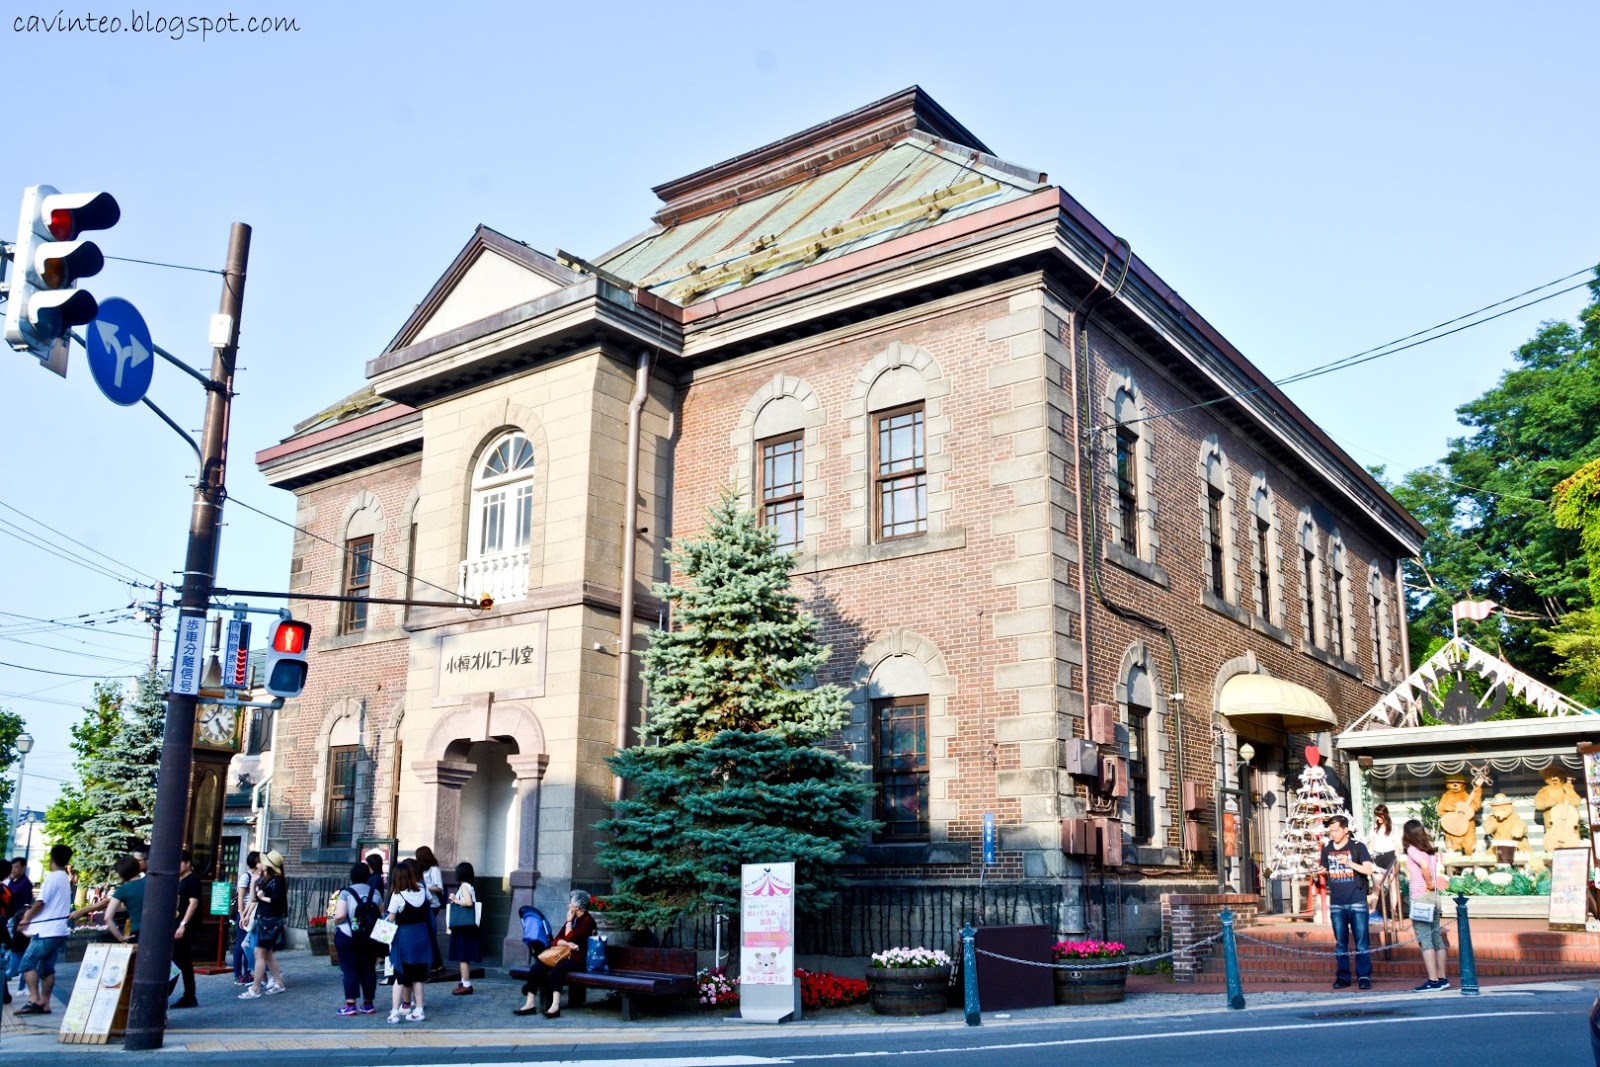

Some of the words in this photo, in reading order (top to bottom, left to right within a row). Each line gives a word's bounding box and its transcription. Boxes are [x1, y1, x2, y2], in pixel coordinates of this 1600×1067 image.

[179, 619, 200, 693] 歩車分離信号
[445, 645, 534, 674] 小樽オルゴール堂
